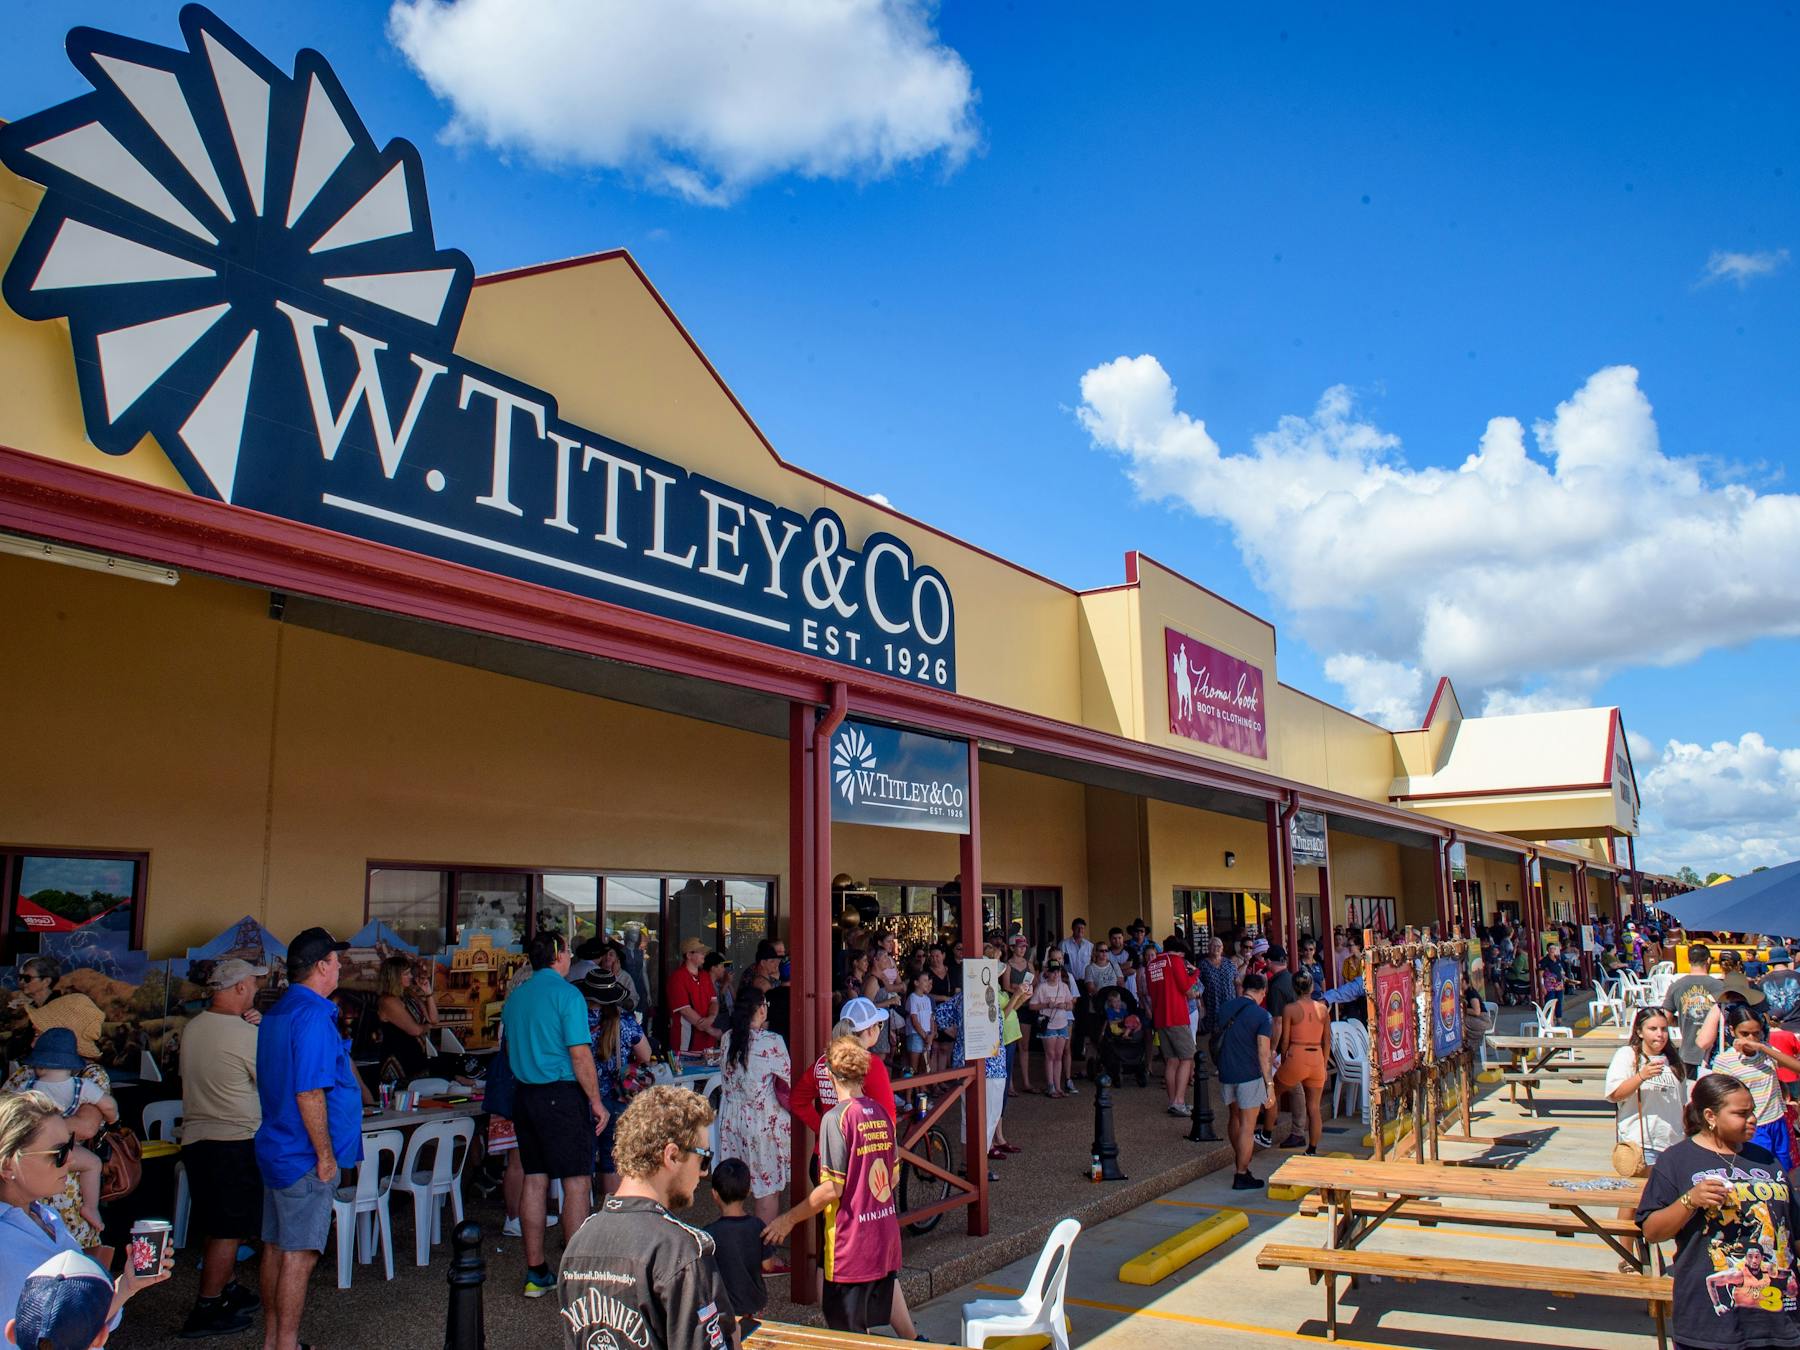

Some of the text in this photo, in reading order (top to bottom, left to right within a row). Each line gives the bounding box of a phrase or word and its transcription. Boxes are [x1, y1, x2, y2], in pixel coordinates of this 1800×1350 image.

[803, 620, 948, 685] EST. 1926
[1196, 702, 1215, 716] BOOT
[1222, 711, 1252, 728] CLOTHING
[930, 807, 963, 818] EST. 1926
[1776, 1170, 1786, 1183] &
[858, 1207, 889, 1223] MINJAR
